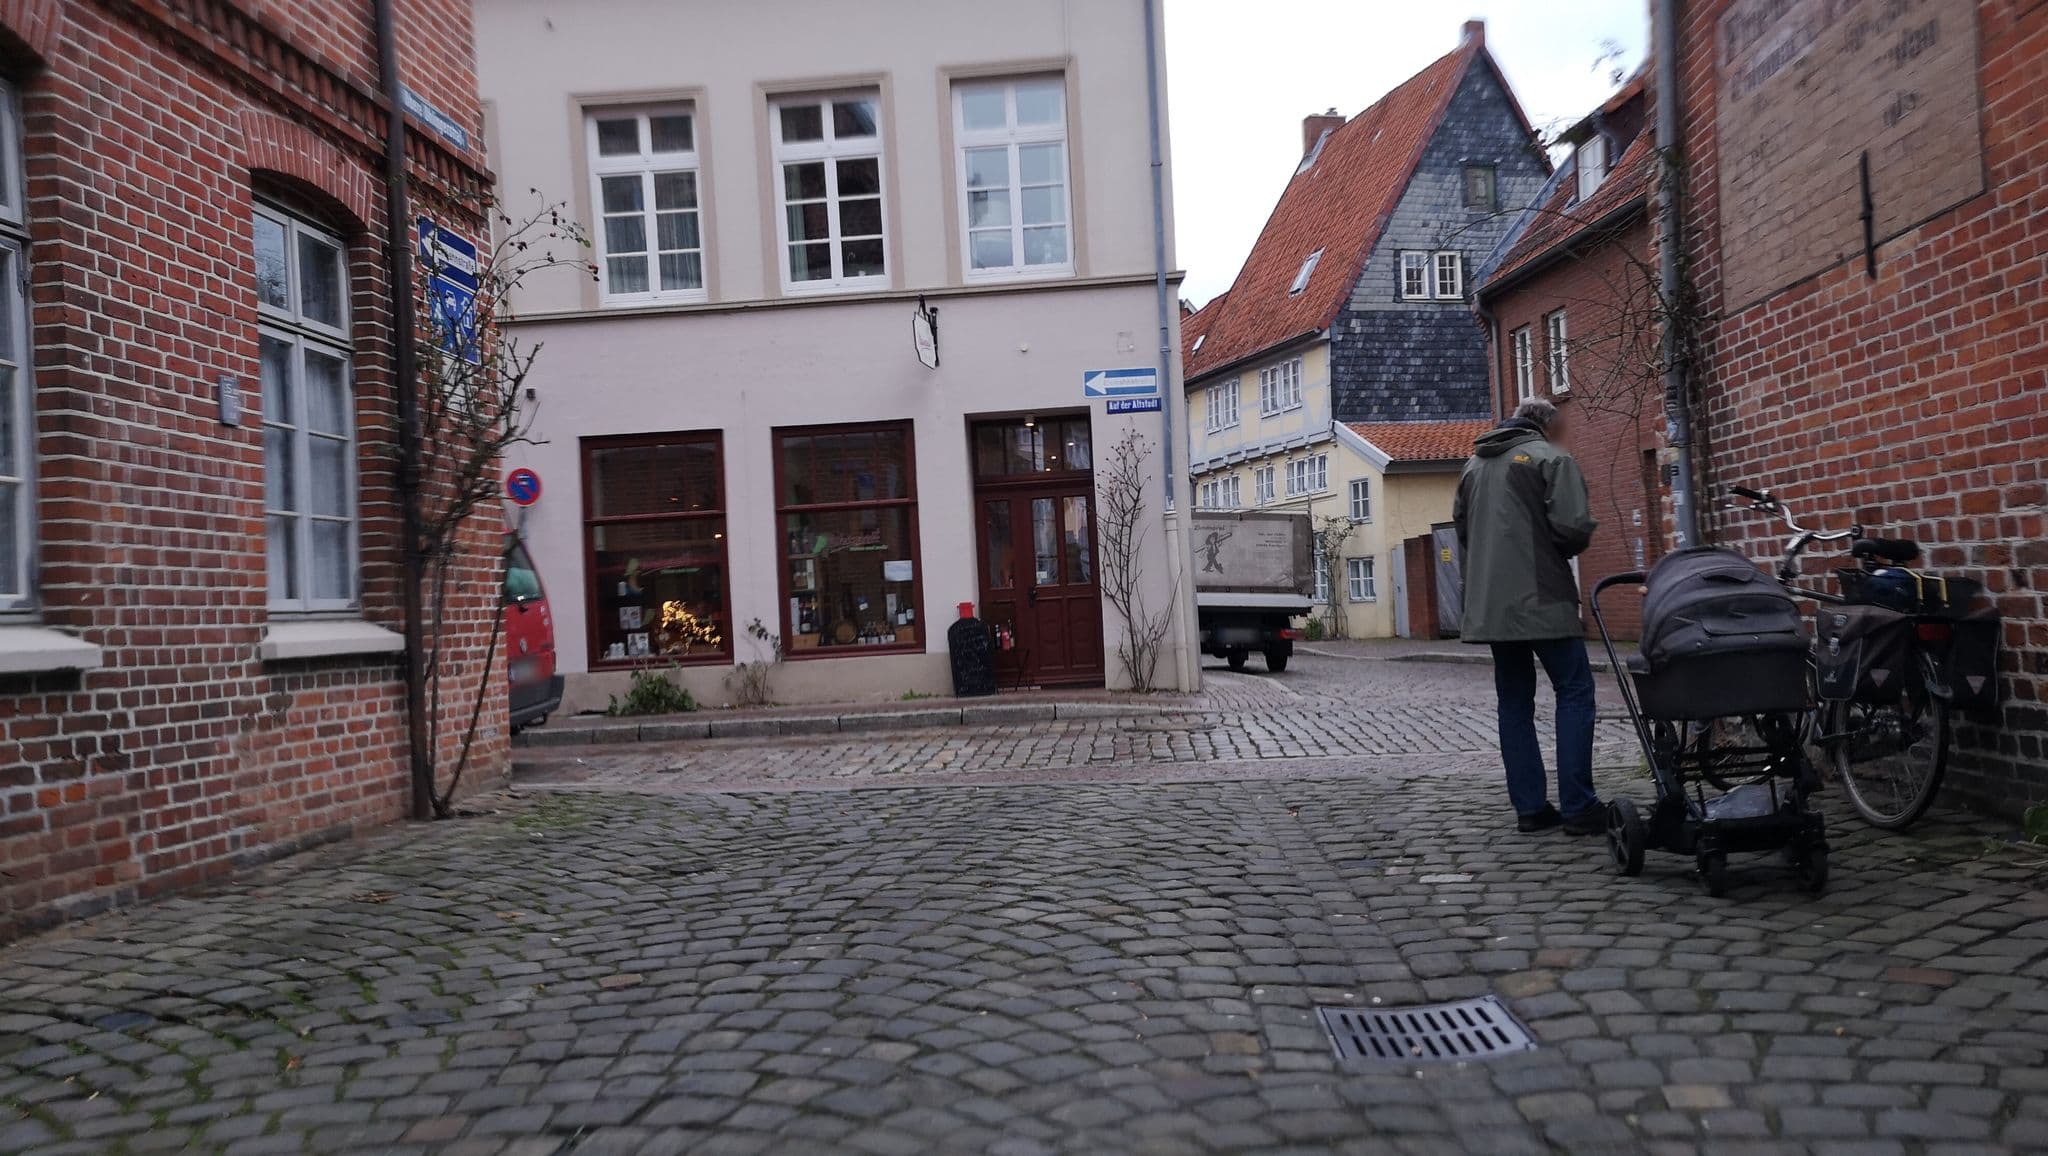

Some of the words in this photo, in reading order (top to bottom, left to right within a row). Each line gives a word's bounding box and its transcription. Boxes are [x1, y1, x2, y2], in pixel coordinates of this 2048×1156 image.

[1109, 401, 1120, 410] Auf
[1120, 401, 1131, 409] der
[1132, 399, 1157, 409] Altstadt
